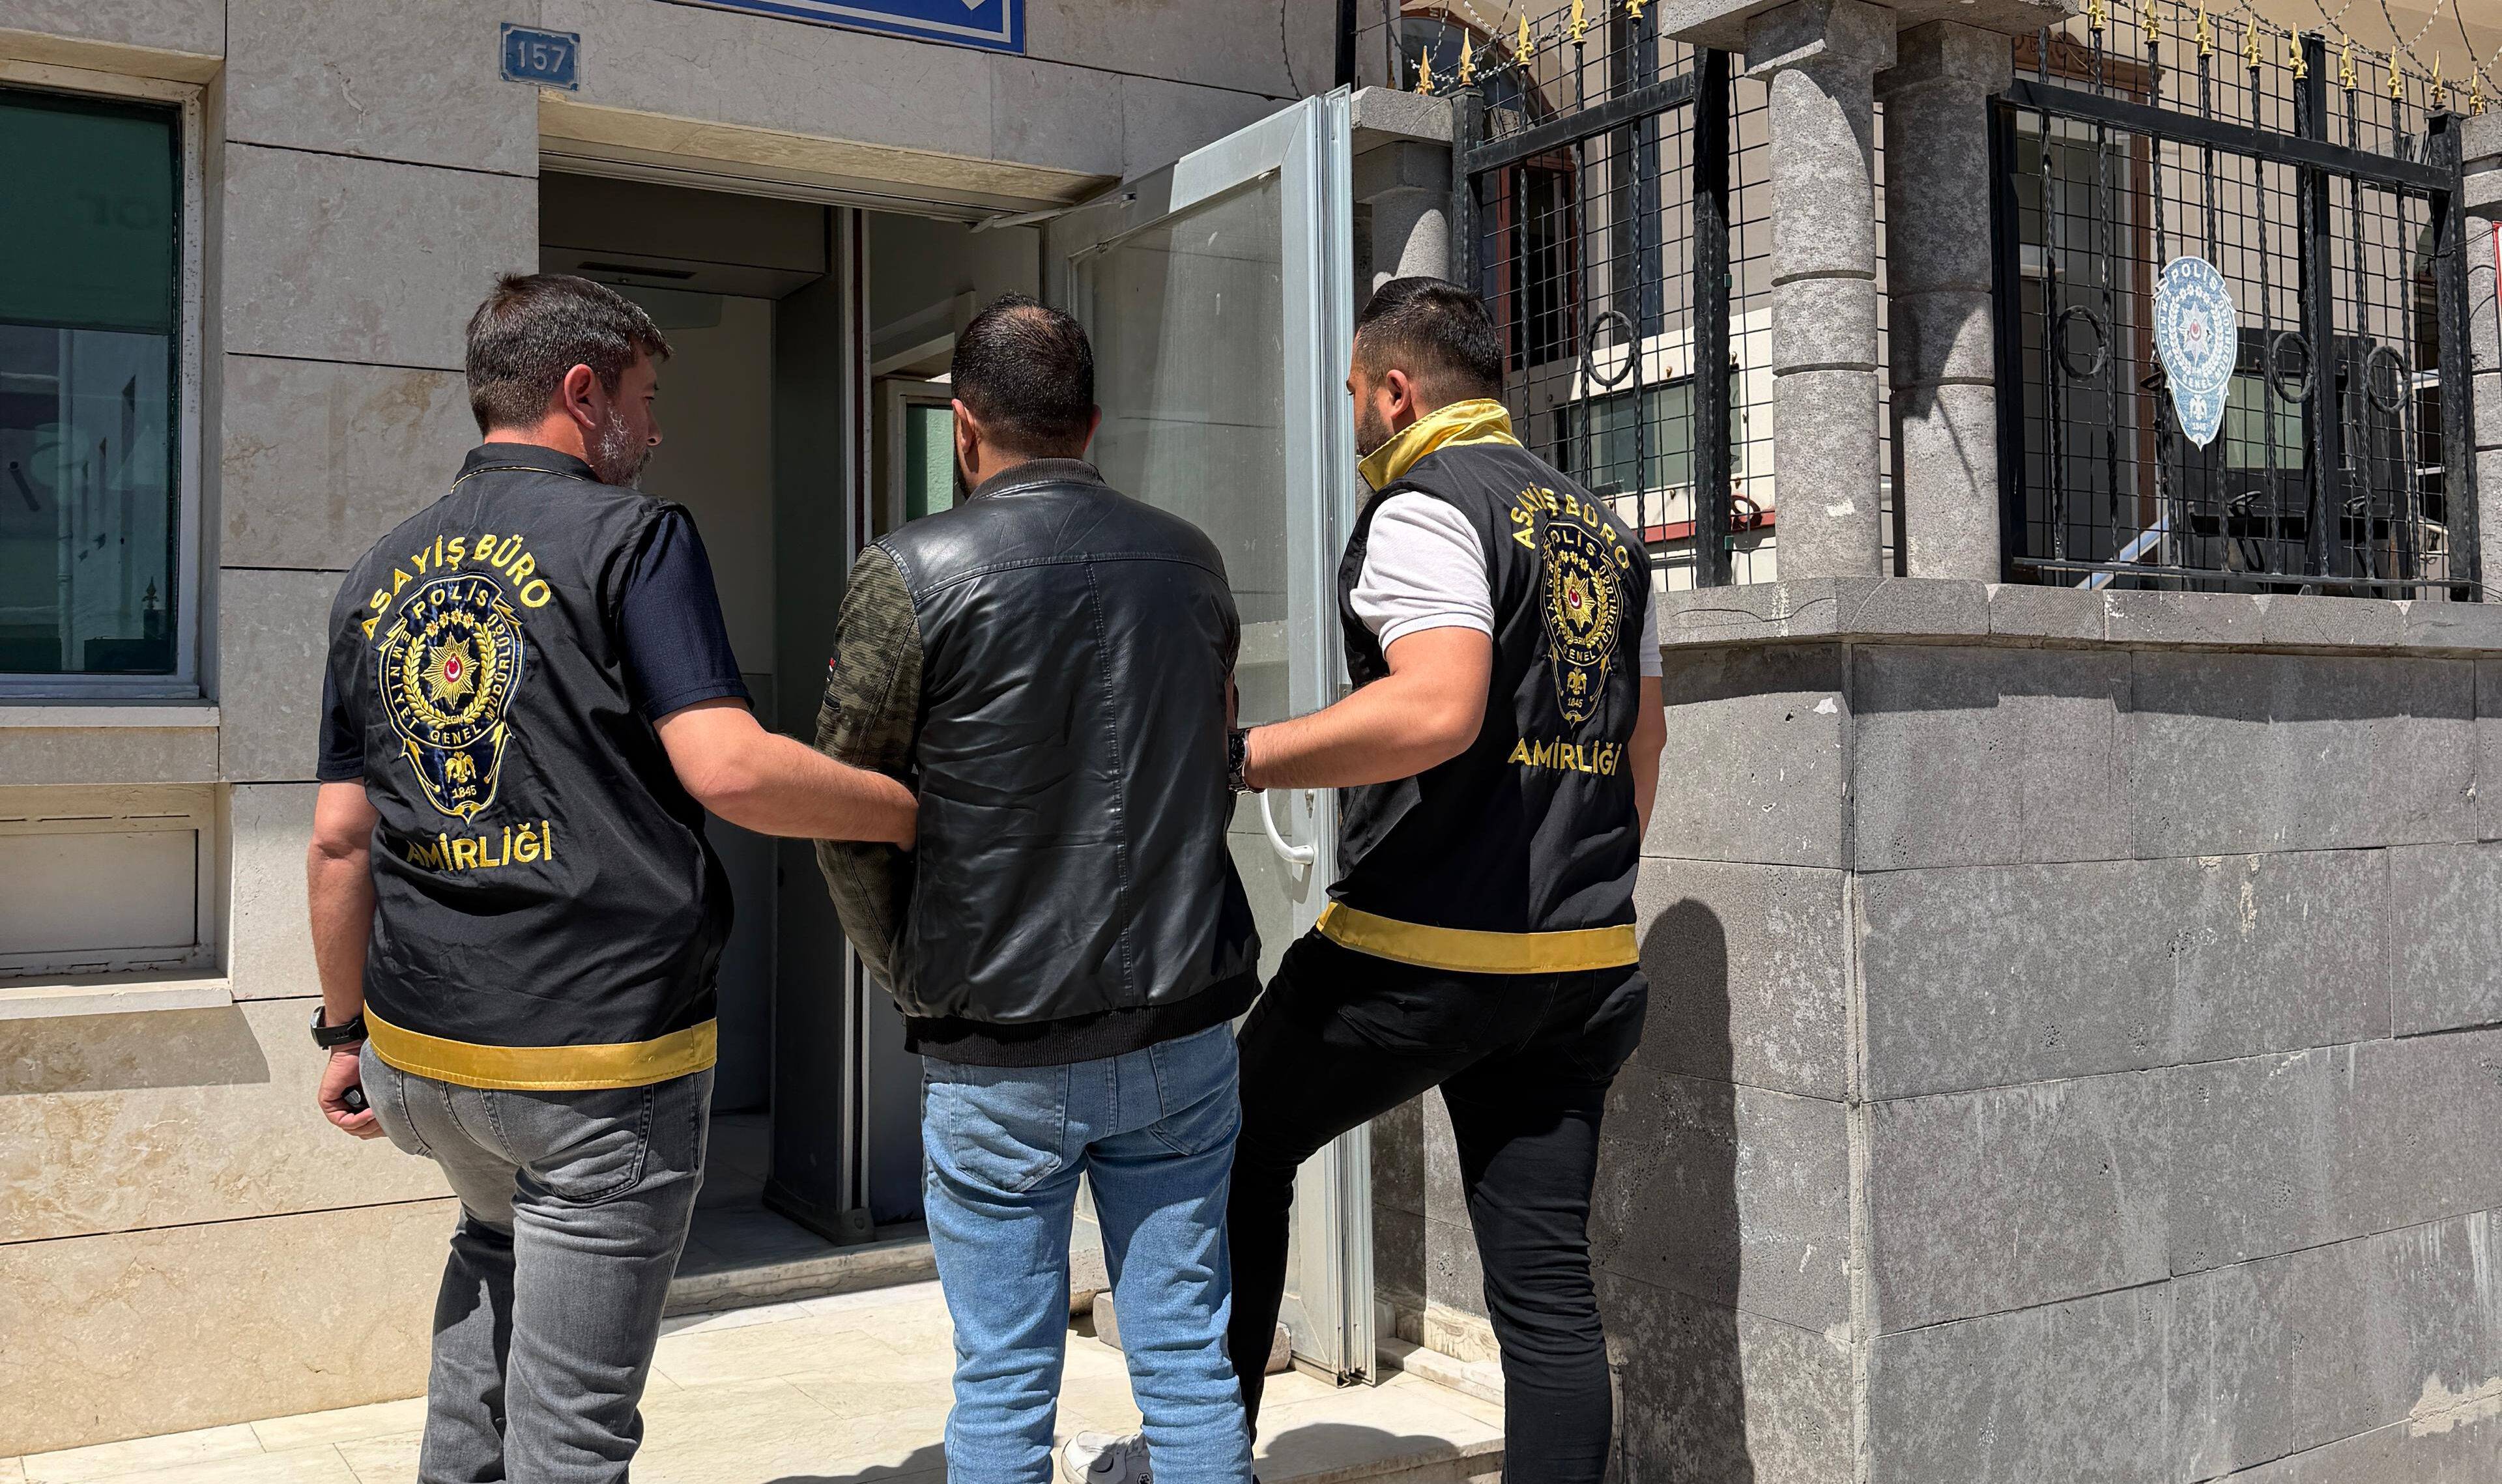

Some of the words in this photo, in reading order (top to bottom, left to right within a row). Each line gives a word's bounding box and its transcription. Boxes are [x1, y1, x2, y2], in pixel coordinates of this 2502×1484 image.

[519, 41, 568, 73] 157
[362, 534, 466, 640] ASAYİŞ
[472, 534, 551, 608] BÜRO
[429, 724, 482, 745] GENEL
[1507, 735, 1622, 776] AMİRLİĞİ
[452, 784, 477, 799] 1845
[407, 820, 552, 872] AMİRLİĞİ
